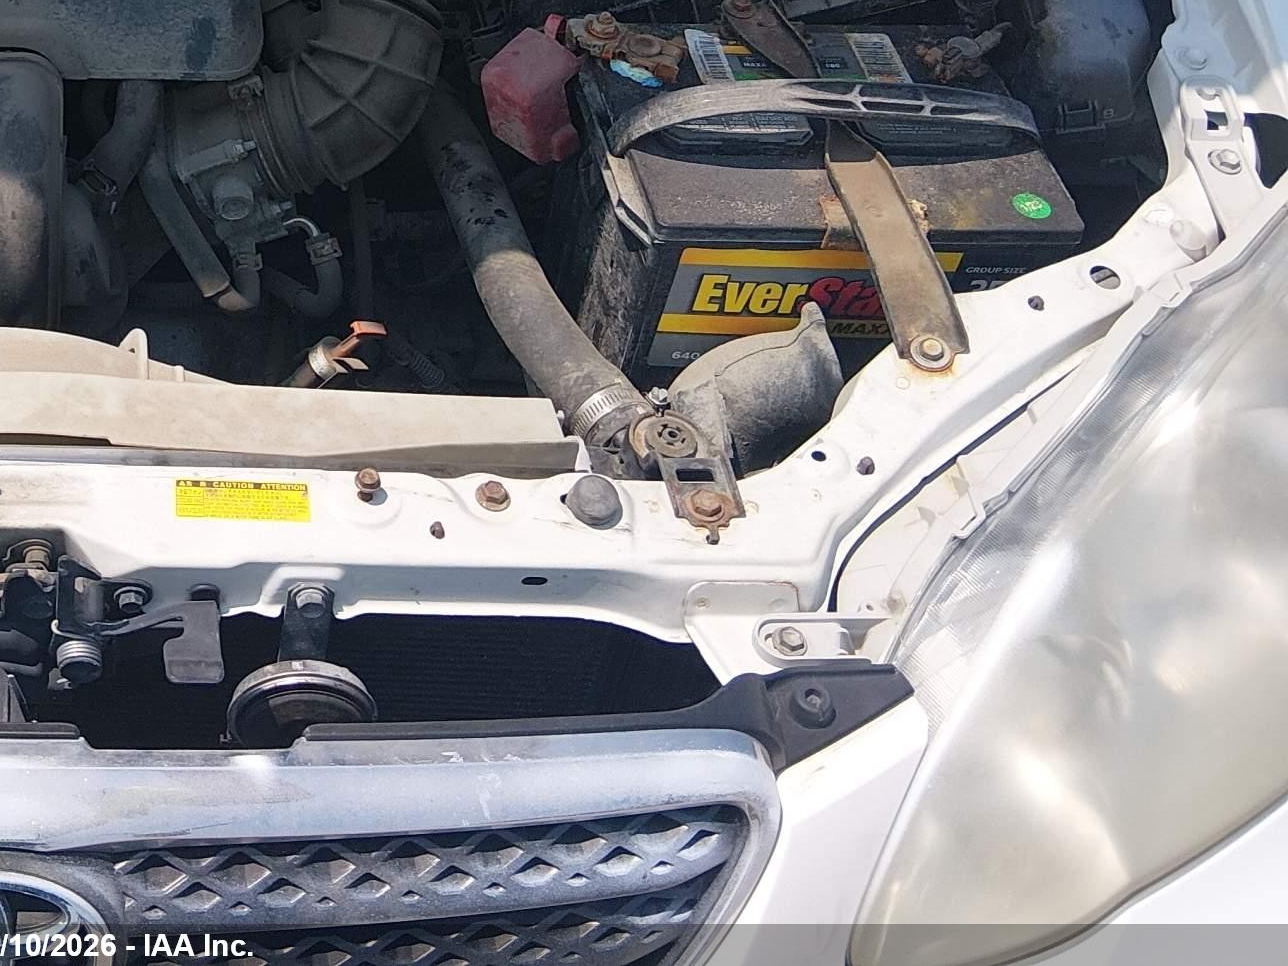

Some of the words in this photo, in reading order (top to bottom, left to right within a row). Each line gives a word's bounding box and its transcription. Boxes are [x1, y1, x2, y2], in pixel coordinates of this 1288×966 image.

[965, 266, 1003, 274] GROUP
[672, 351, 701, 360] 640
[212, 481, 255, 490] CAUTION
[260, 483, 307, 492] ATTENTION
